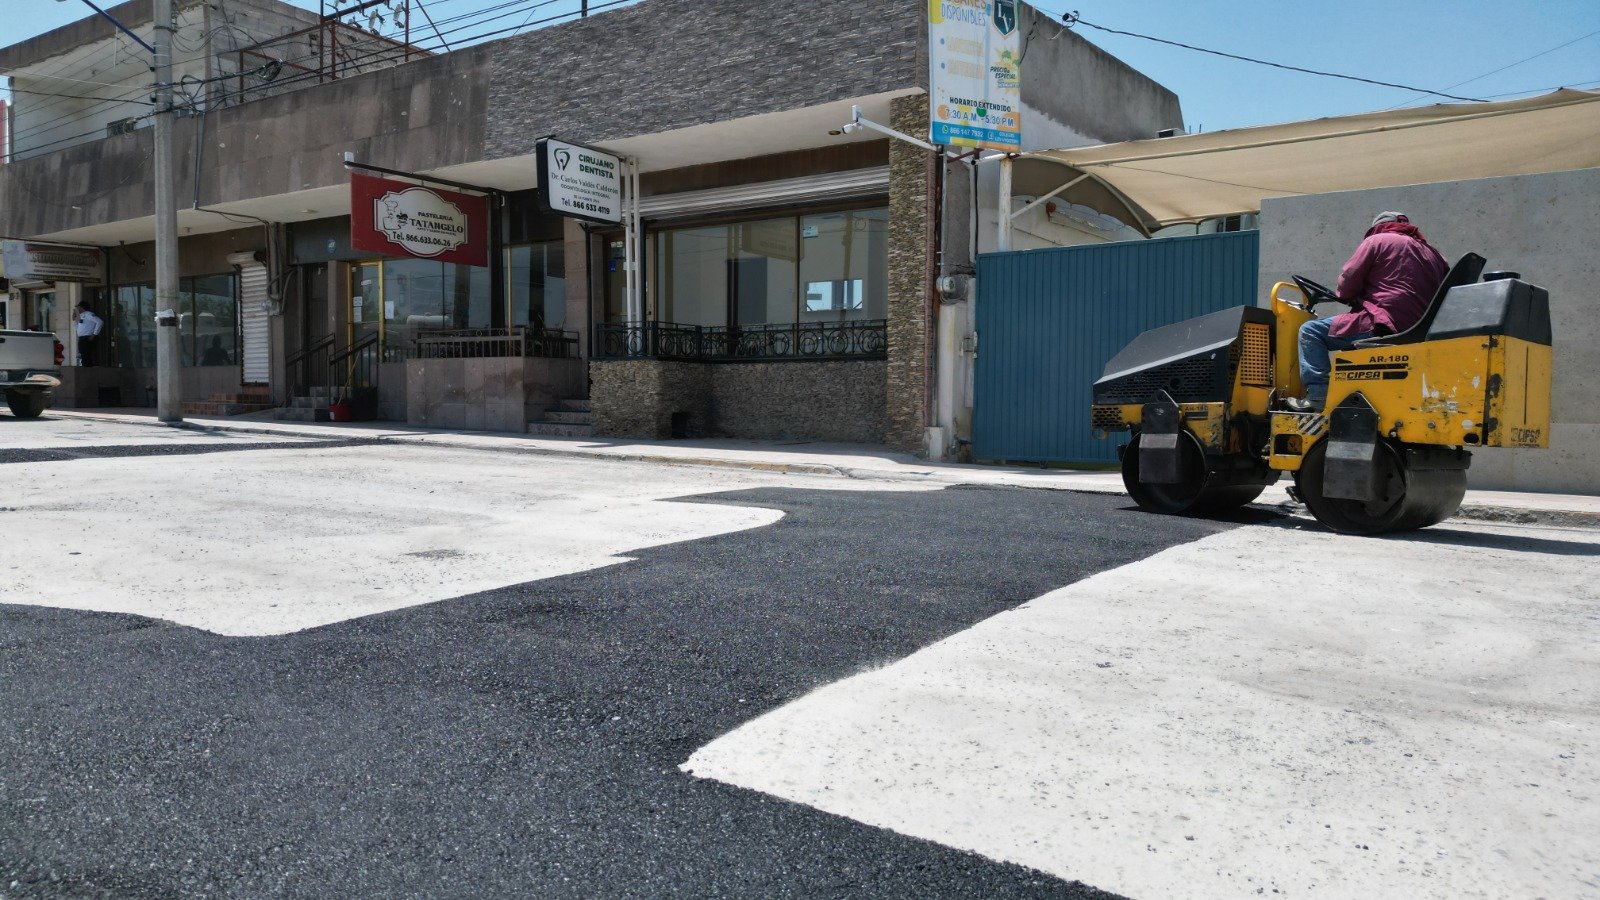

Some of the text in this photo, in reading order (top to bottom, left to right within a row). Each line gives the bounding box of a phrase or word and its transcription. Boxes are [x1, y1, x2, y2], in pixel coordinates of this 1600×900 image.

[942, 4, 986, 26] DISPONIBLES
[950, 97, 1012, 112] HORARIO EXTENDIDO
[578, 154, 614, 170] CIRUJANO
[551, 172, 560, 180] Dr.
[560, 175, 578, 185] Carlos
[579, 164, 614, 180] DENTISTA
[561, 197, 572, 207] Tel.
[573, 200, 585, 210] 866
[586, 203, 597, 212] 633
[598, 206, 611, 215] 4119
[409, 218, 464, 234] TATANGELO
[392, 231, 451, 247] Tel. 866.633.06.26
[1347, 371, 1380, 380] CIPSA
